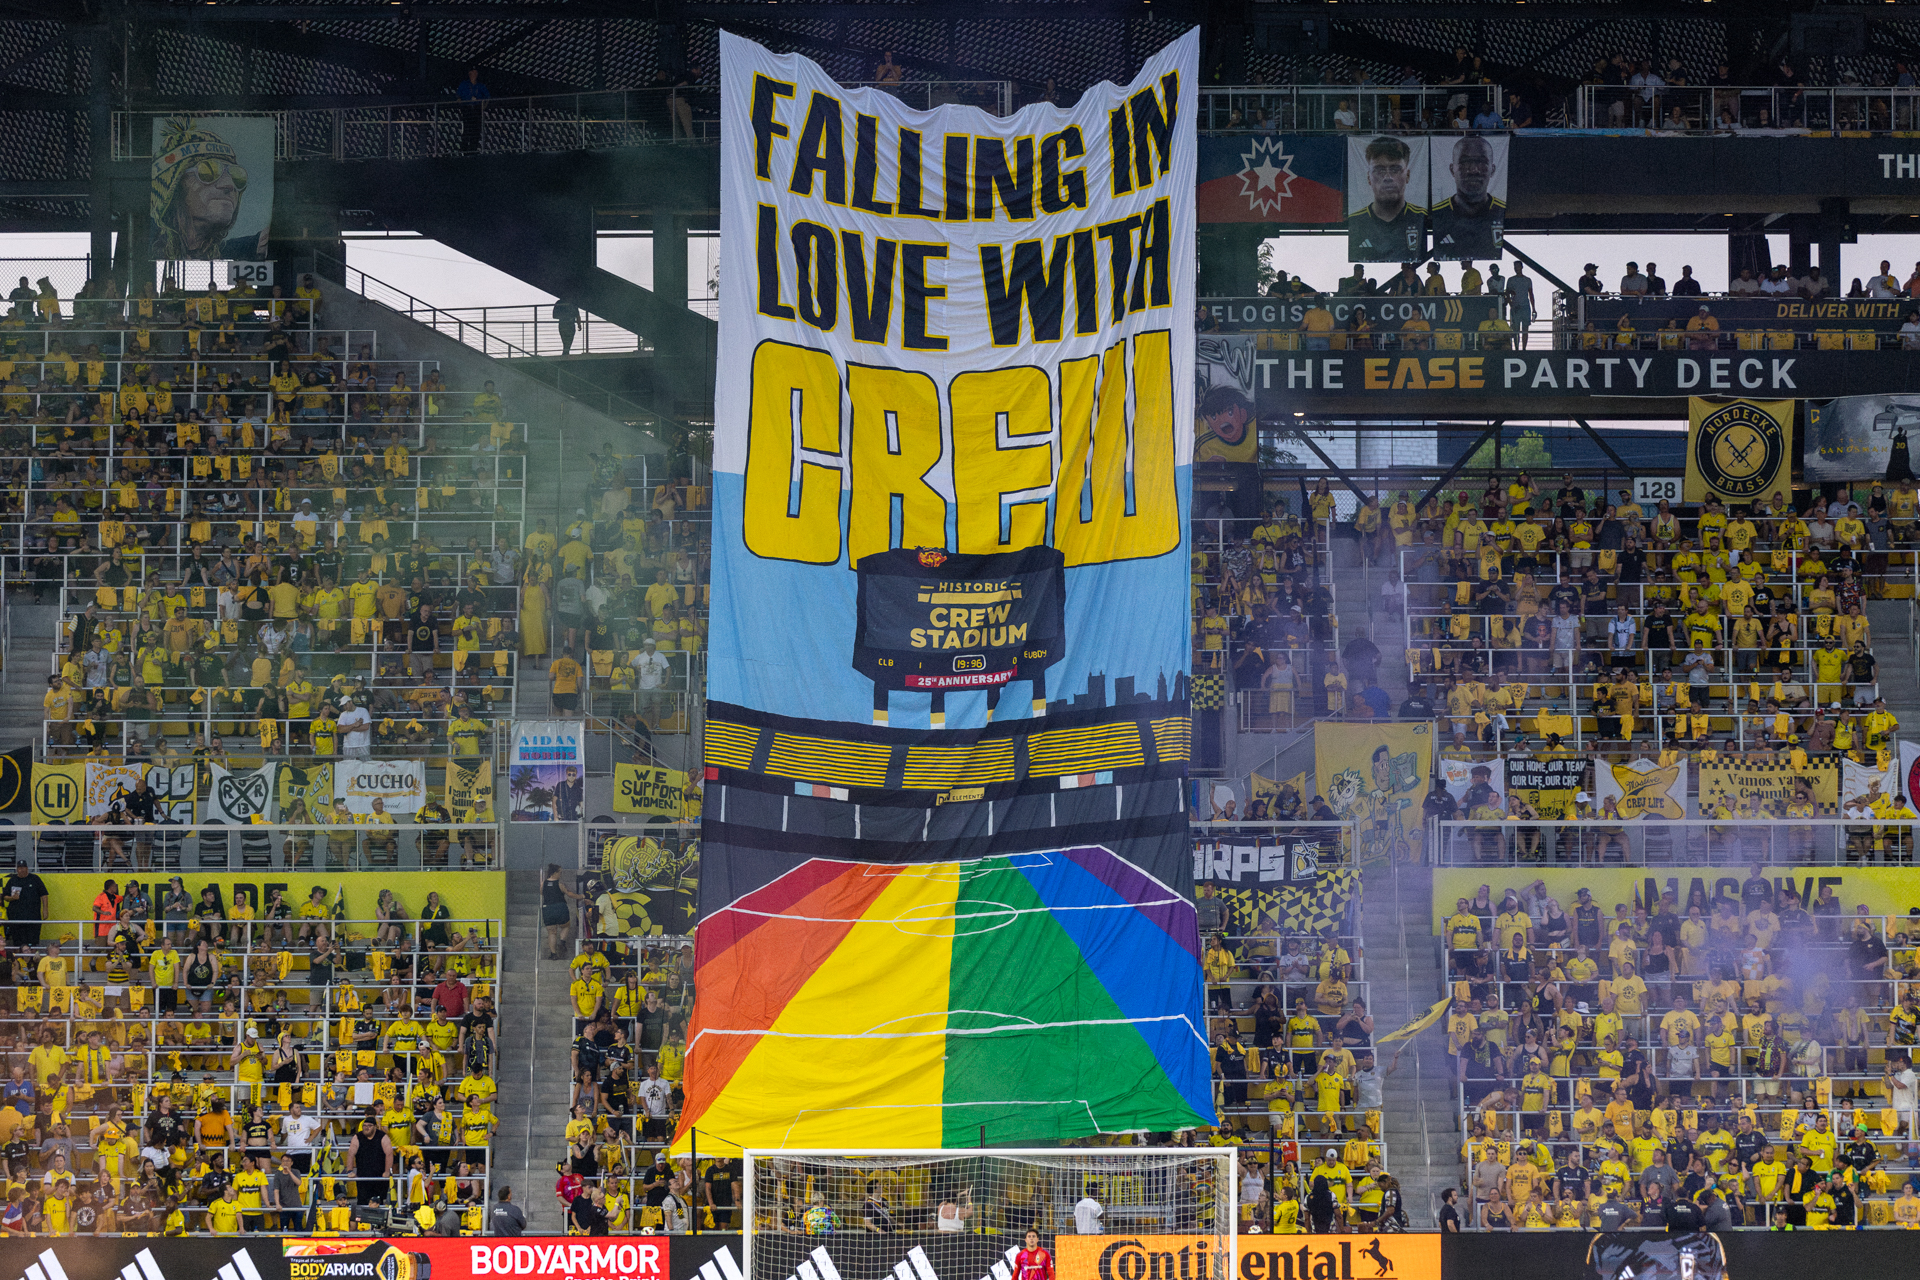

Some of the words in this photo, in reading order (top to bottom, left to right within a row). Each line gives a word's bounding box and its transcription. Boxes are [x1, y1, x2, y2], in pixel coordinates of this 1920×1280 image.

[181, 143, 200, 157] MY
[205, 143, 231, 153] CREW
[750, 71, 1088, 221] FALLING
[1107, 69, 1180, 199] IN
[1878, 154, 1920, 178] TH
[232, 265, 268, 281] 126
[756, 201, 949, 352] LOVE
[980, 196, 1170, 348] WITH
[1777, 304, 1848, 318] DELIVER
[1854, 304, 1900, 318] WITH
[1256, 358, 1344, 389] THE
[1364, 357, 1485, 390] EASE
[1503, 358, 1652, 389] PARTY
[1677, 358, 1797, 389] DECK
[1706, 408, 1777, 437] NORDECKE
[742, 328, 1180, 571] CREW
[1639, 481, 1676, 498] 128
[1716, 476, 1765, 493] BRASS
[939, 581, 1007, 592] HISTORIC
[929, 603, 1011, 628] CREW
[910, 622, 1027, 650] STADIUM
[878, 658, 894, 667] CLB
[956, 658, 983, 669] 19:96
[938, 671, 1013, 687] ANNIVERSARY
[519, 735, 576, 745] AIDAN
[520, 751, 576, 760] MORRIS
[1510, 760, 1524, 772] OUR
[634, 769, 667, 784] WE
[1511, 775, 1526, 786] OUR
[1562, 775, 1579, 786] CRE
[1778, 775, 1820, 786] vaos
[44, 783, 71, 808] LH
[621, 779, 683, 799] SUPPORT
[952, 793, 984, 801] ELEMENTS
[1740, 787, 1791, 799] Columb
[452, 796, 474, 807] fallin
[630, 796, 677, 810] WOMEN.
[1644, 877, 1842, 917] MASIVE
[470, 1244, 660, 1275] BODYARMOR
[289, 1263, 373, 1276] BODYARMOR
